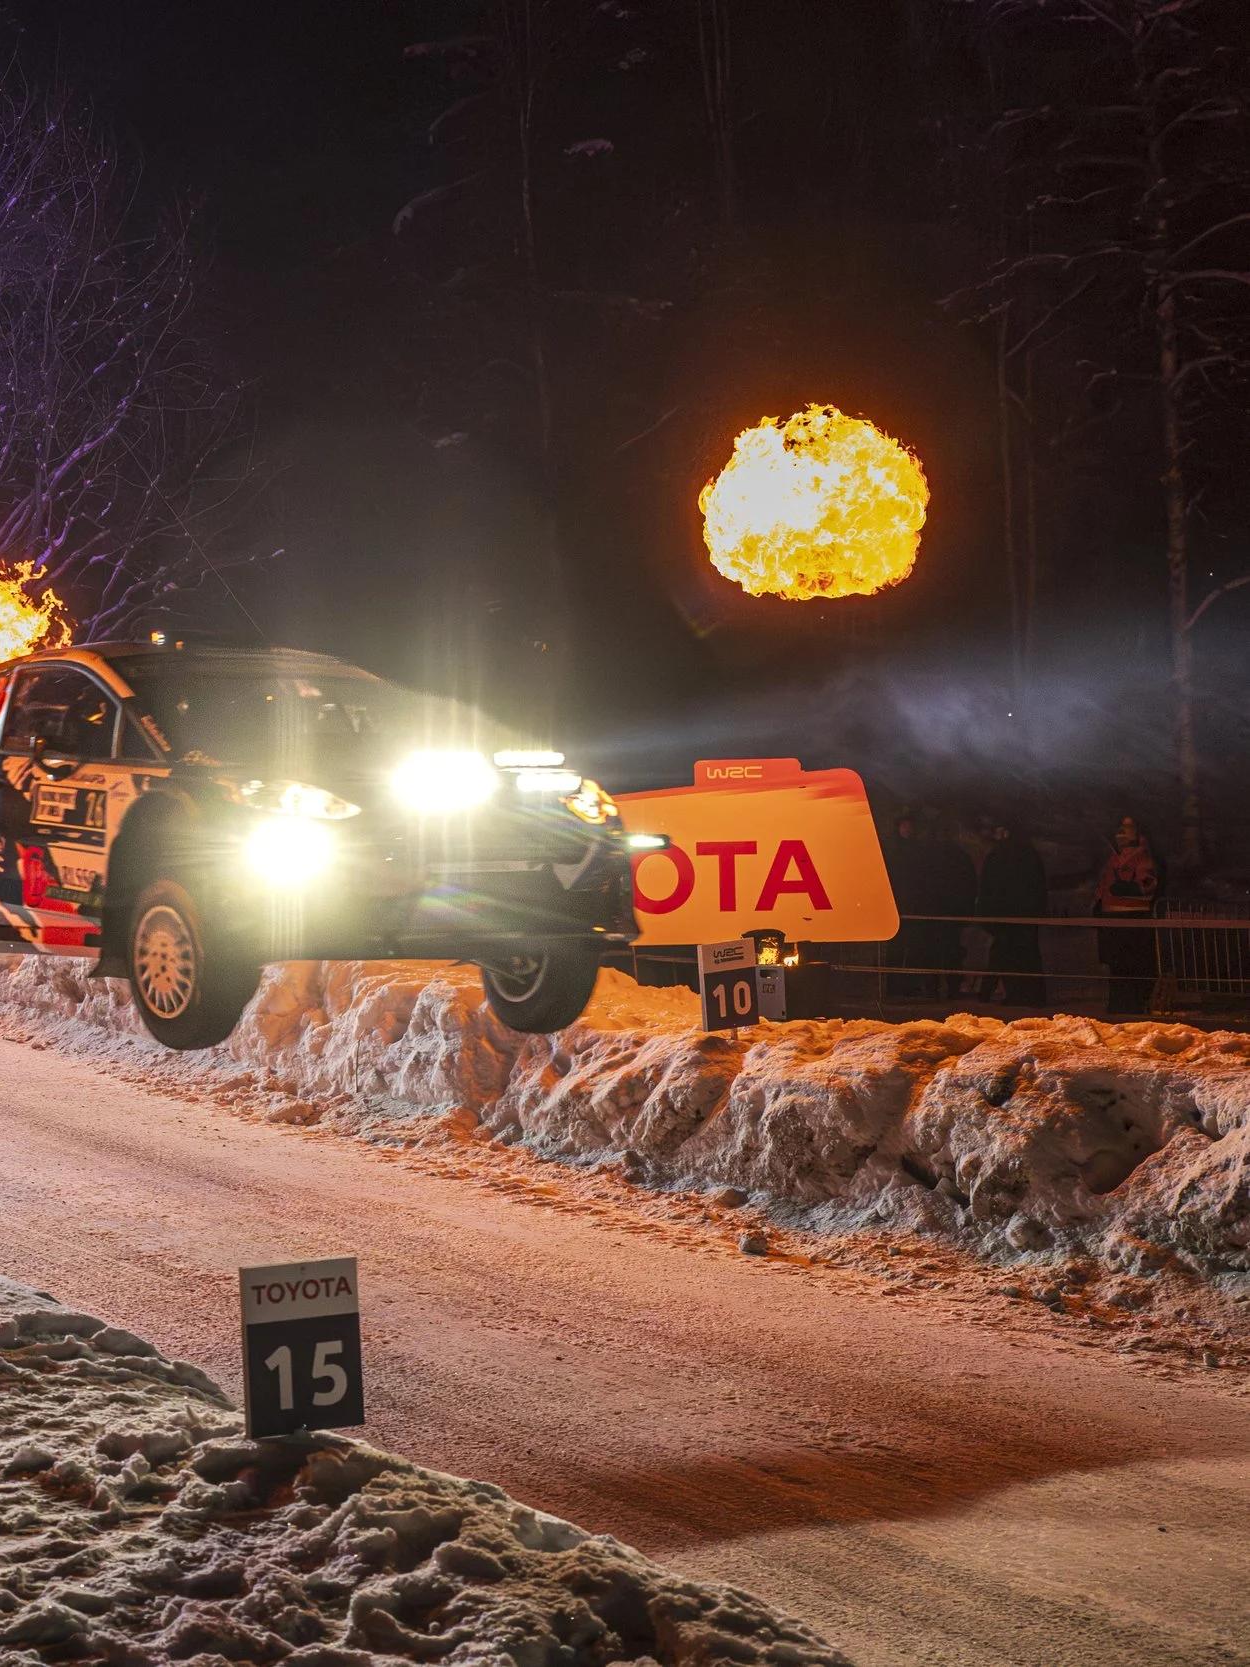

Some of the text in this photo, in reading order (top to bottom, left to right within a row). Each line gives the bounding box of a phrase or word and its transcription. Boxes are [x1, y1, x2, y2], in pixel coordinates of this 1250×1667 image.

[707, 765, 763, 779] WRC
[630, 840, 833, 915] OTA
[713, 946, 744, 959] WRC
[712, 981, 752, 1018] 10
[251, 1275, 352, 1305] TOYOTA
[264, 1340, 348, 1410] 15
